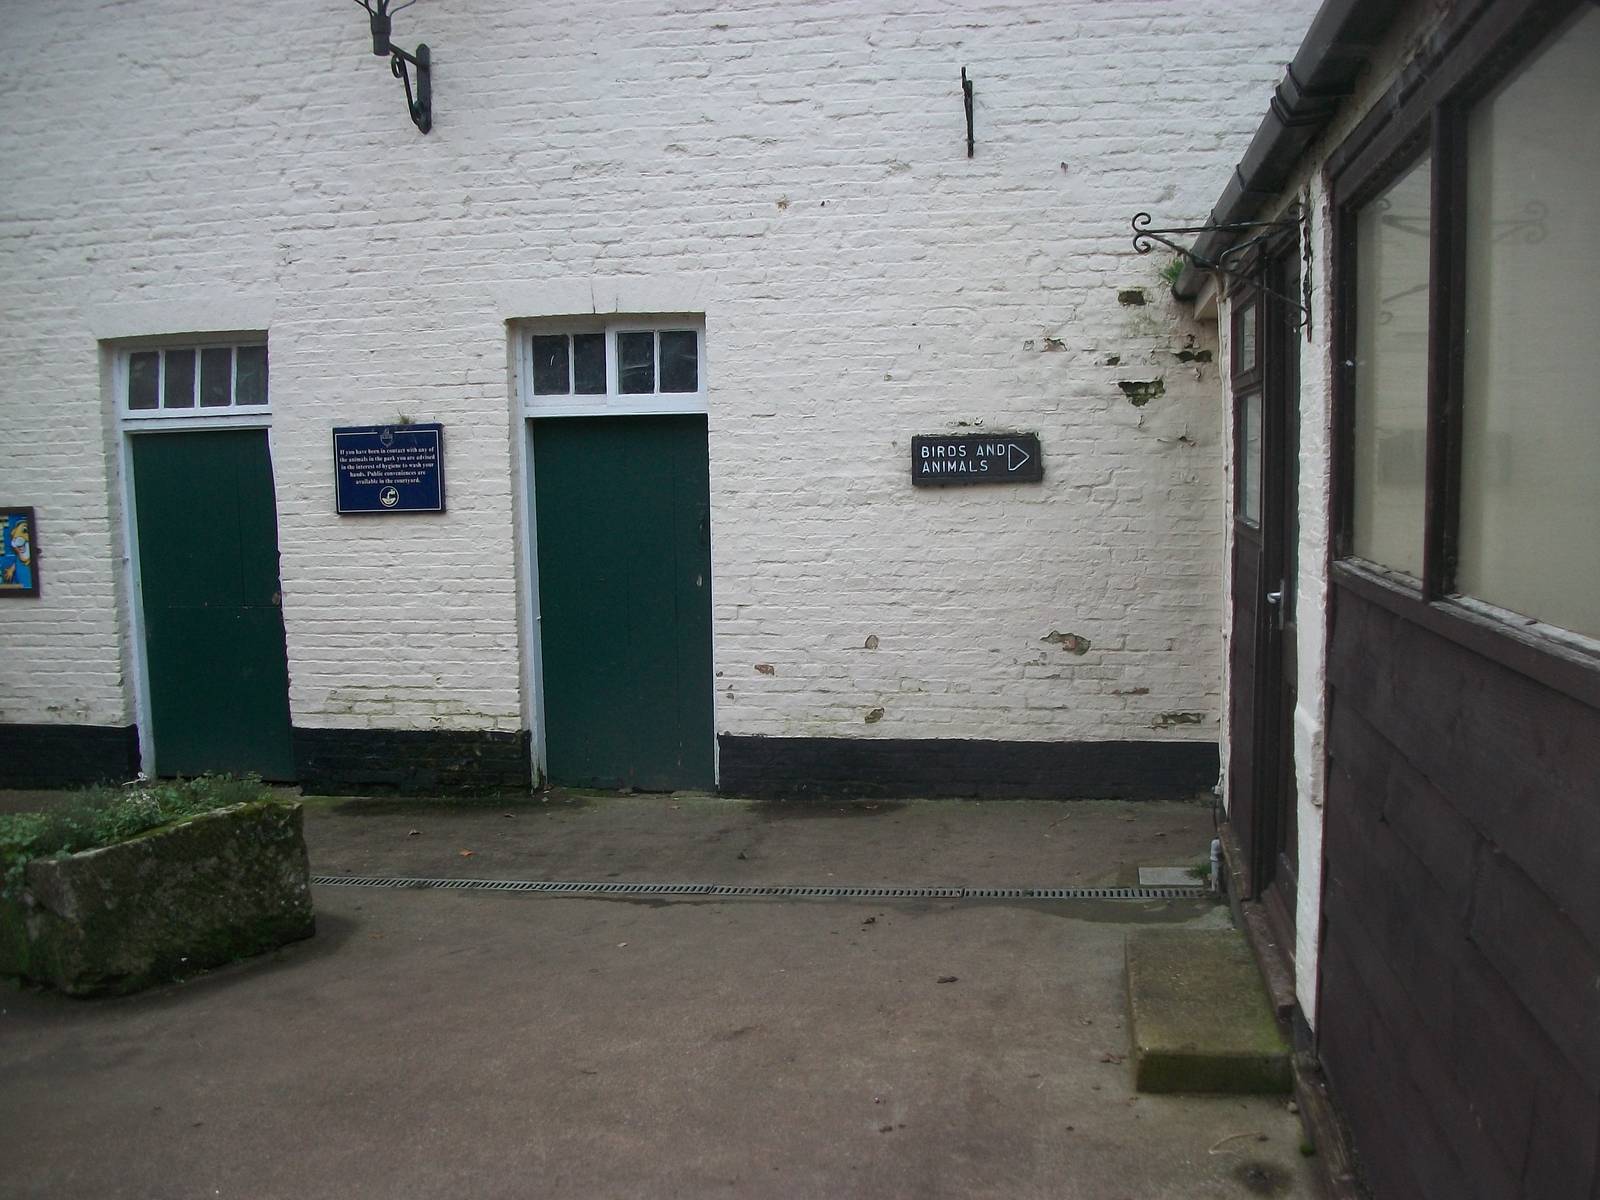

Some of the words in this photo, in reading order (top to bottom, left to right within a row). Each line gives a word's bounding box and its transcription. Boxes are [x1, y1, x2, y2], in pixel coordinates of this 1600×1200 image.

[921, 446, 966, 458] BIRDS
[976, 444, 1005, 456] AND
[922, 460, 988, 473] ANIMALS
